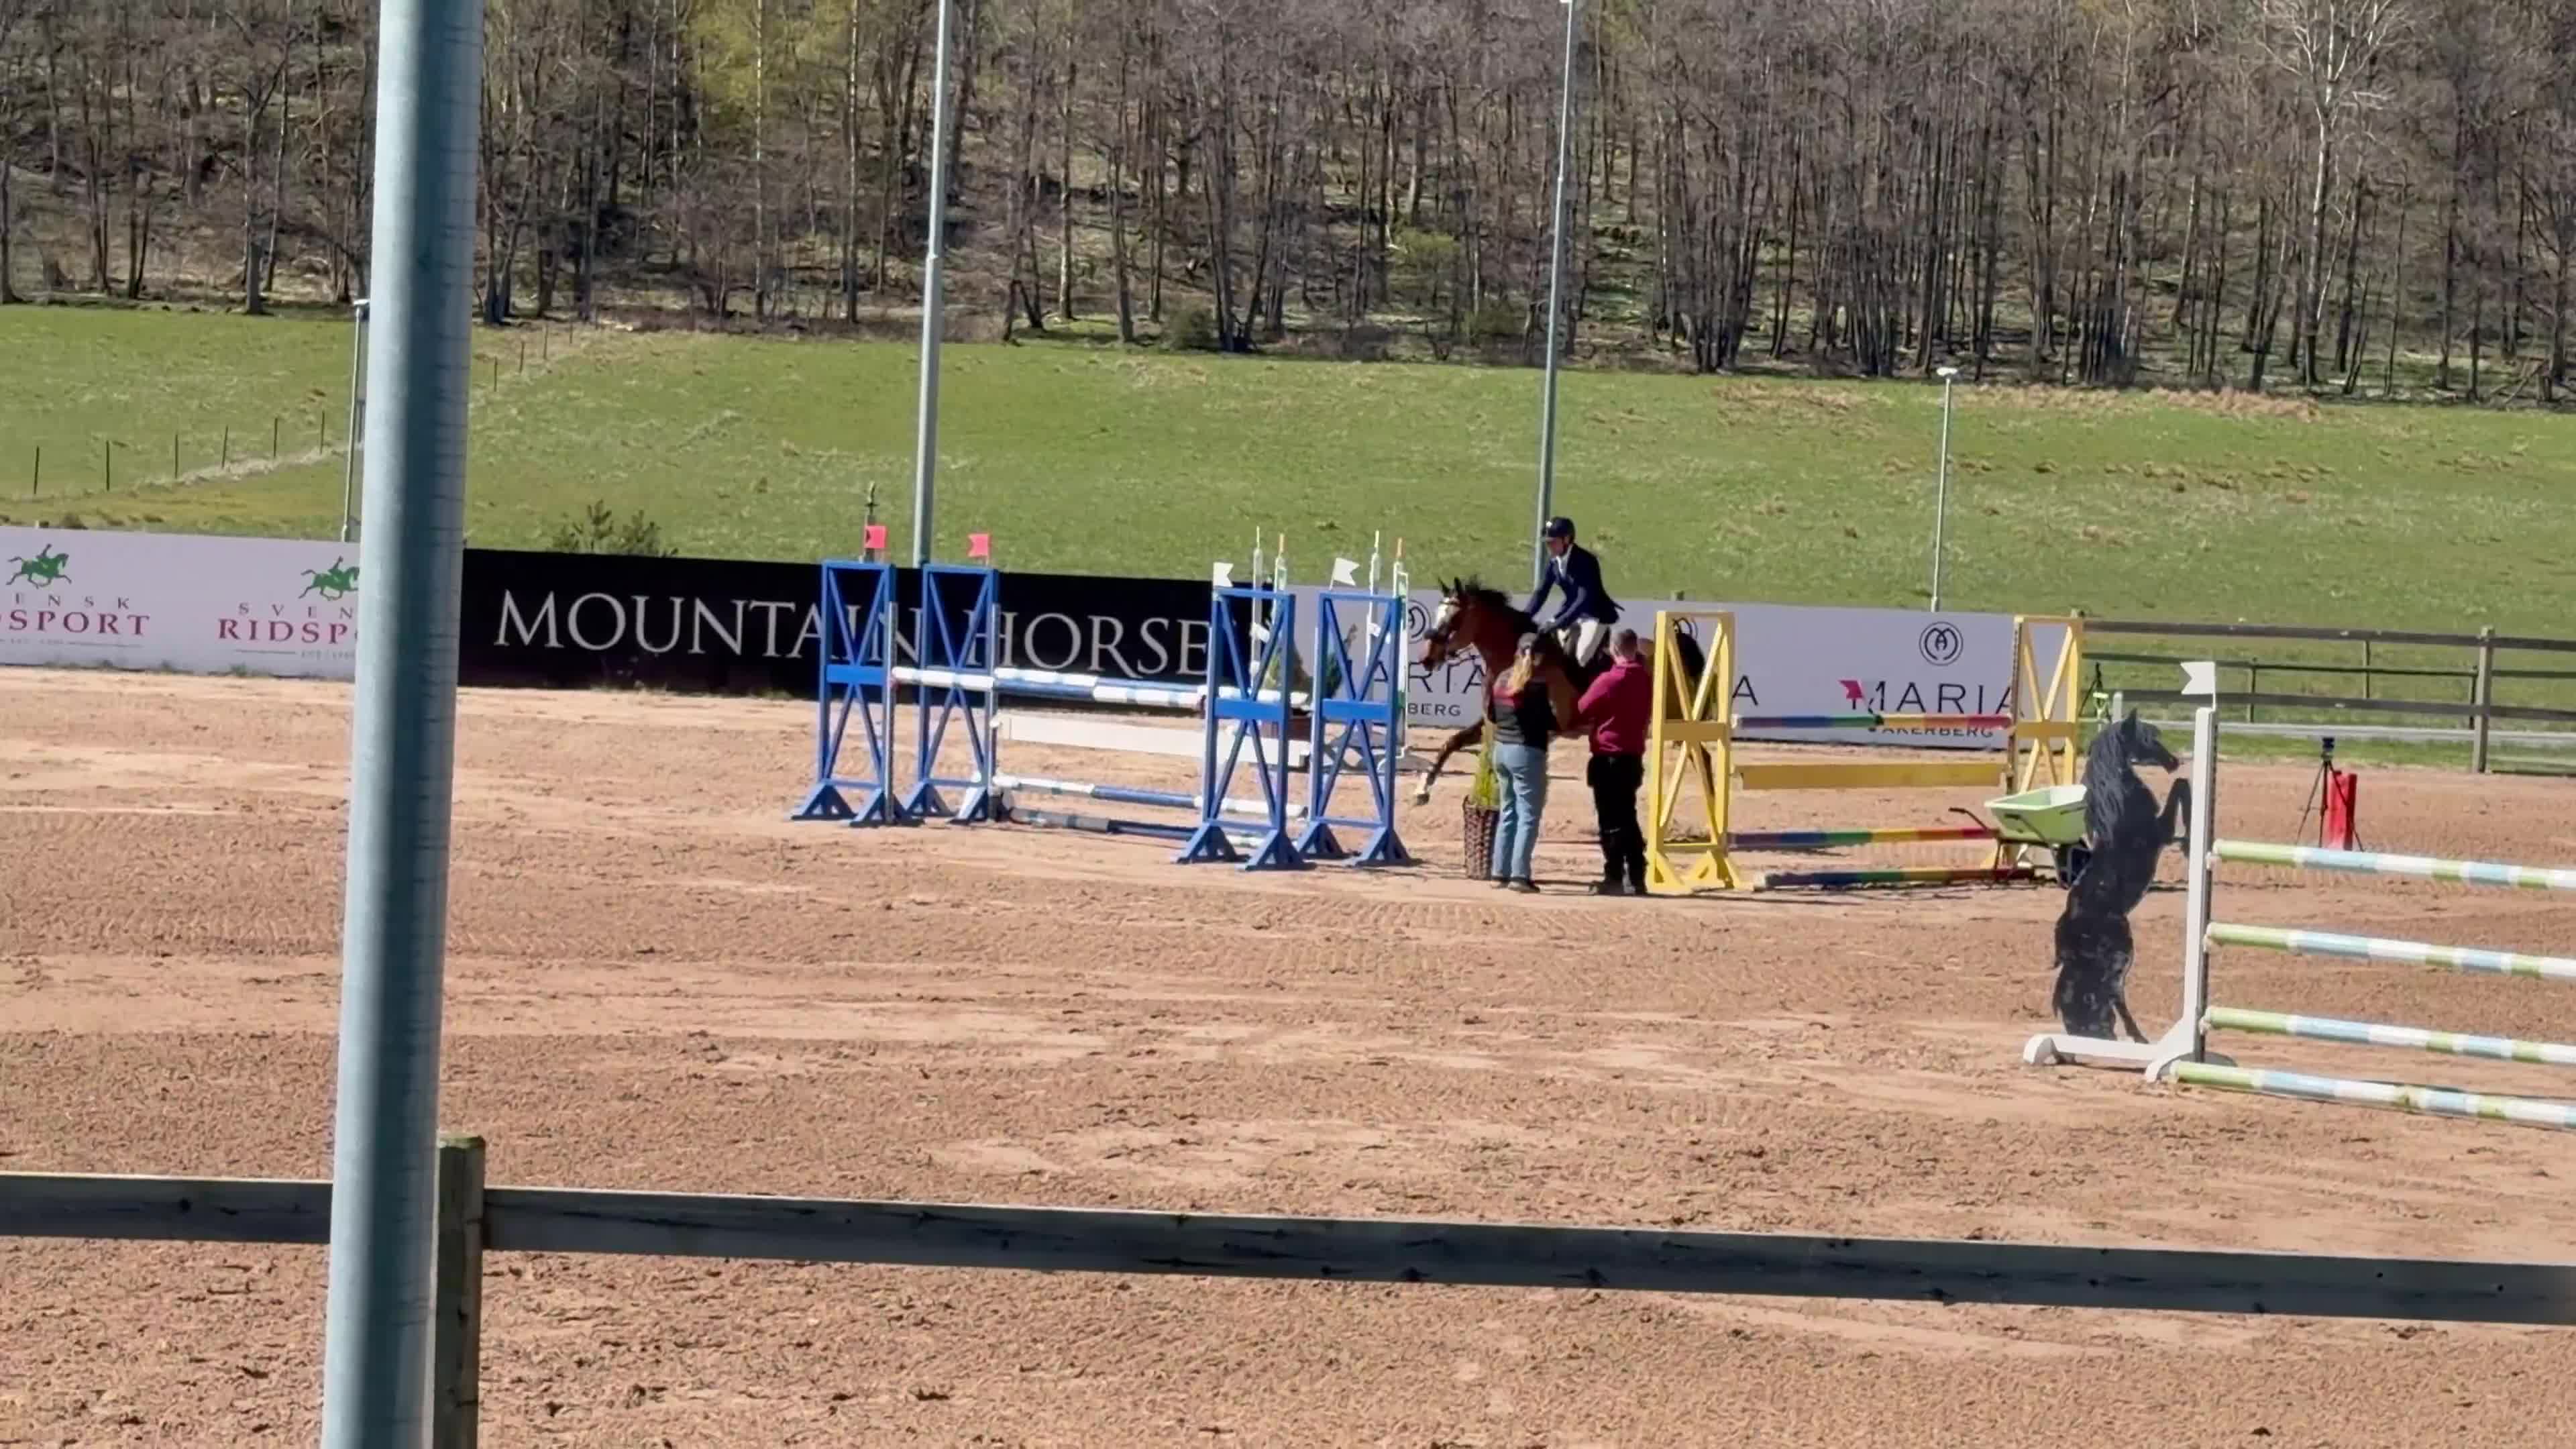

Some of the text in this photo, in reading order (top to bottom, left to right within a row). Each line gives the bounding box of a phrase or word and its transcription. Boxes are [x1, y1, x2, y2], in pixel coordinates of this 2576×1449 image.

[218, 619, 358, 645] RIDSP
[493, 589, 1210, 678] MOUNTAIN HORSE
